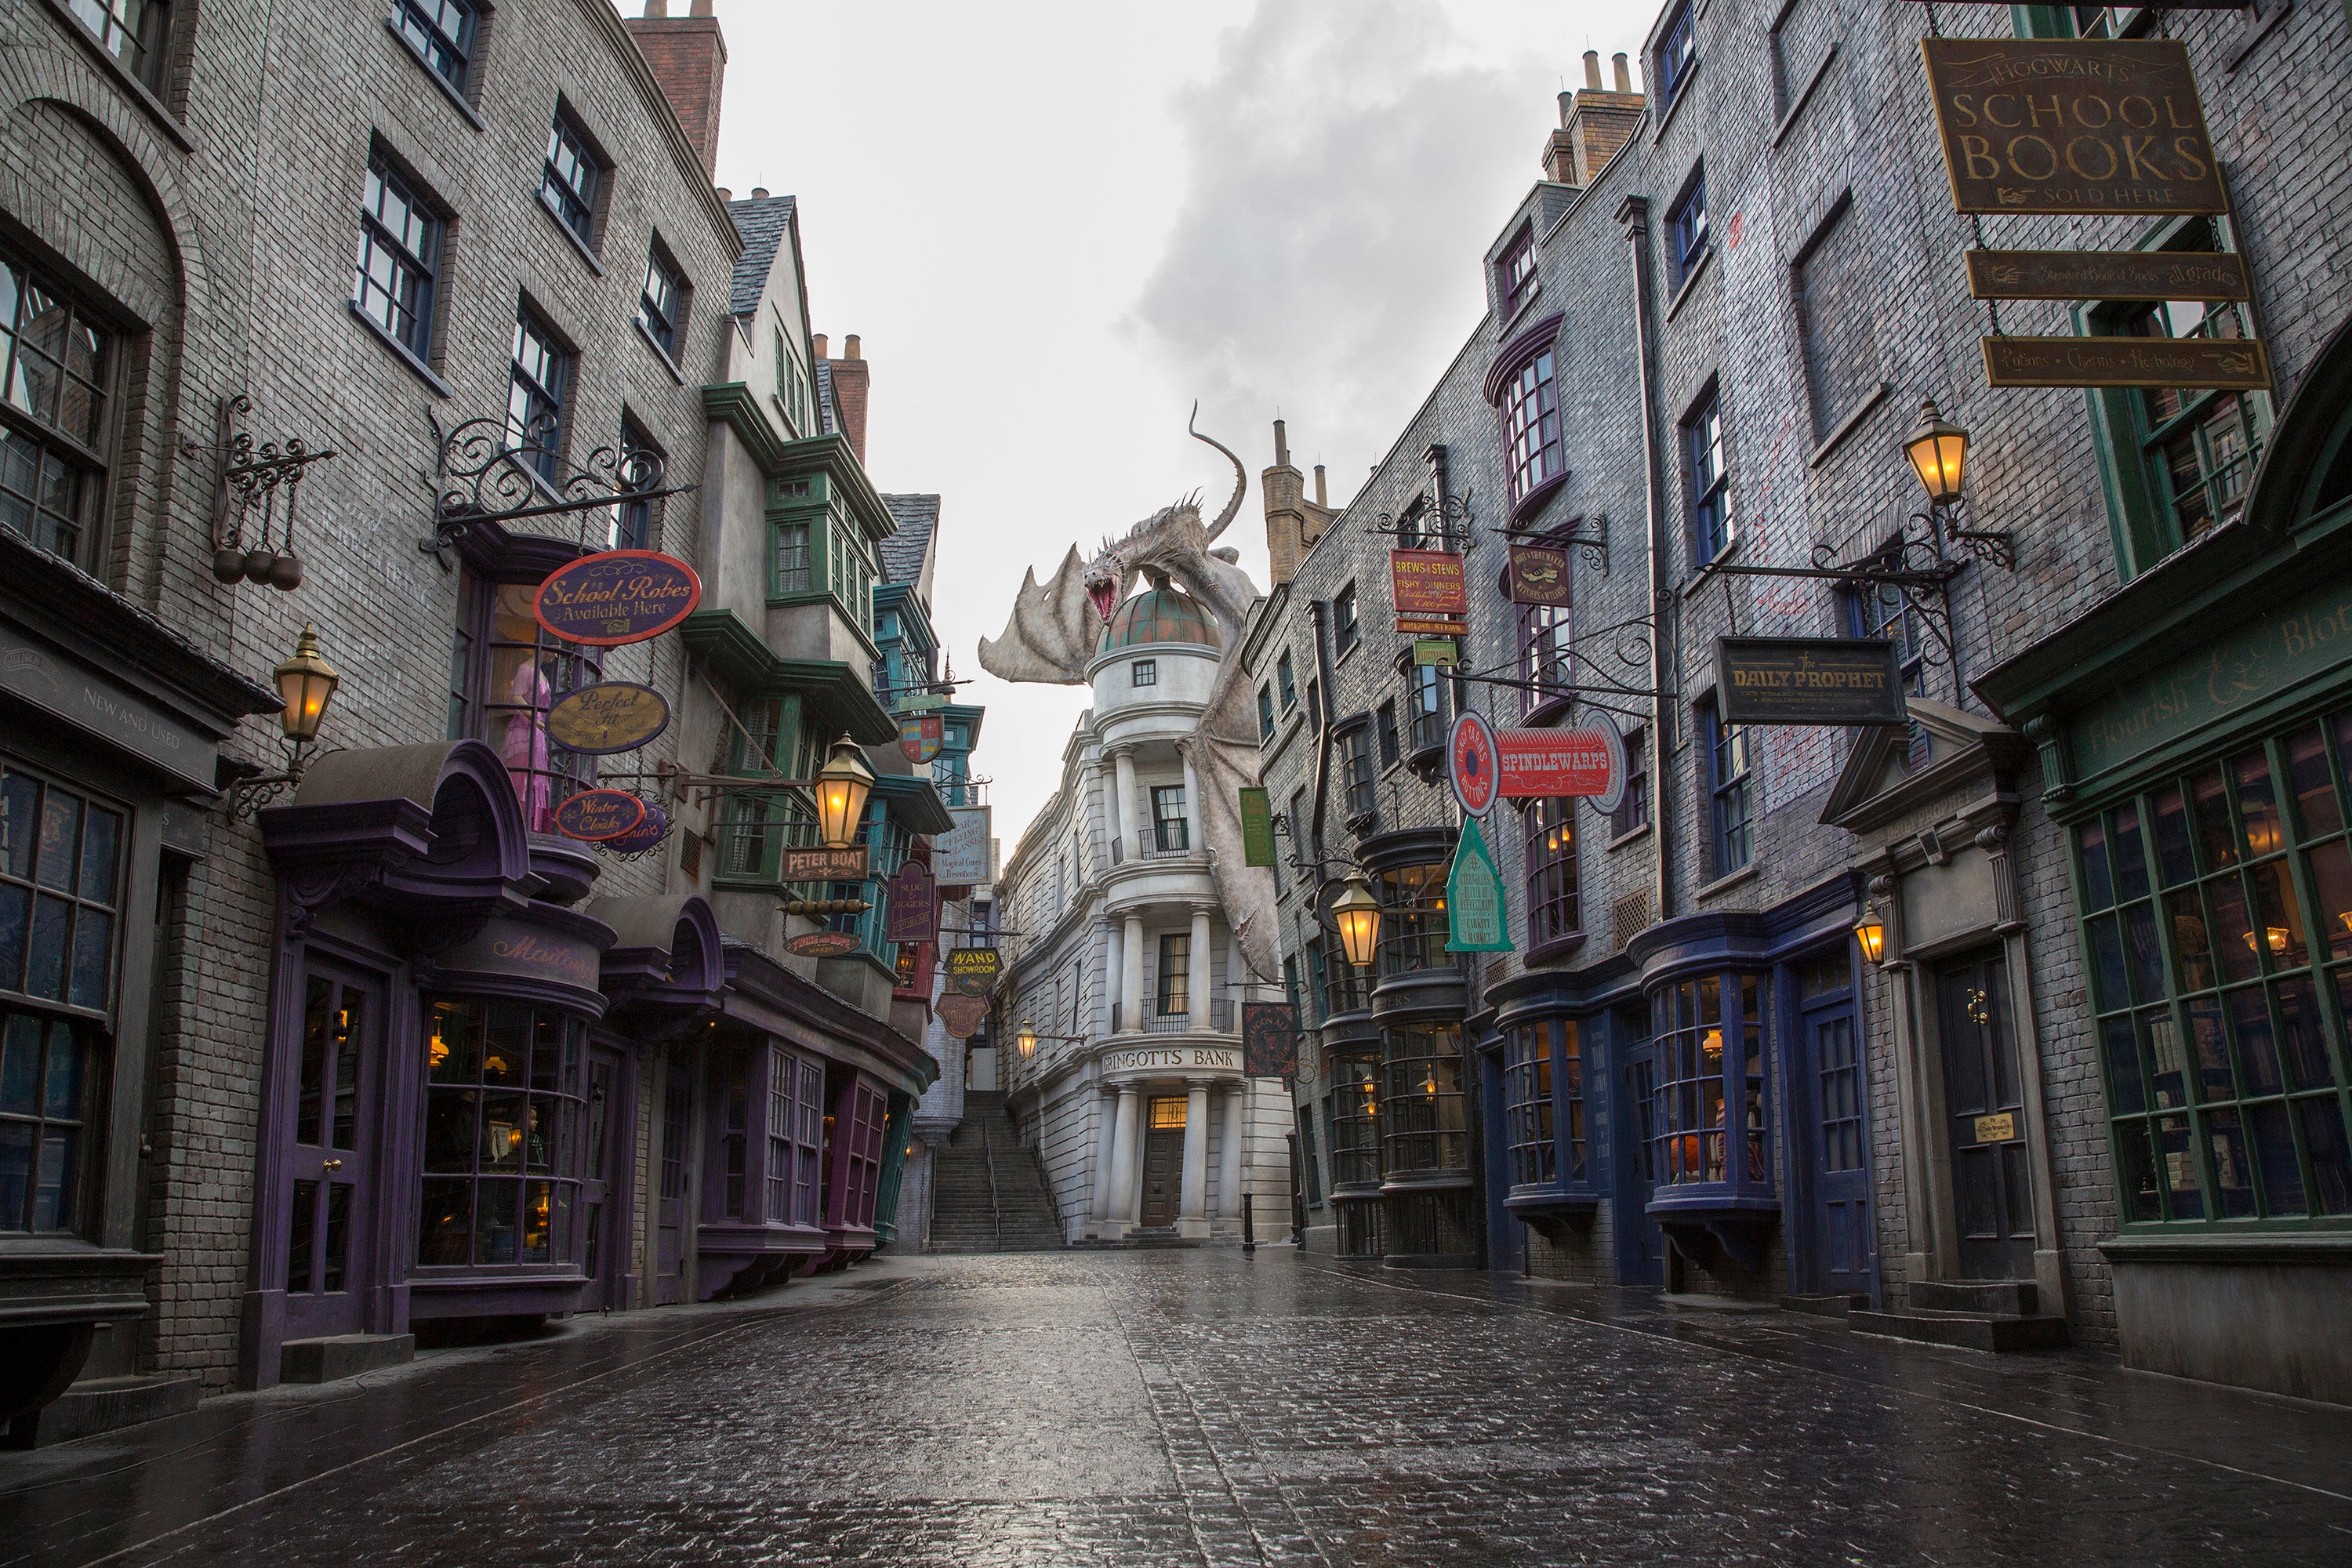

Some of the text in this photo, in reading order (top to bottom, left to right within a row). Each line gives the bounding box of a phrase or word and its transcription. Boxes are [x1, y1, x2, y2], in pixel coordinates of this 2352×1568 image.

[1994, 58, 2132, 83] HOGWARTS
[1953, 93, 2194, 129] SCHOOL
[1958, 134, 2209, 182] BOOKS
[2044, 188, 2178, 205] SOLD HERE
[2041, 264, 2237, 286] Standard Book of Spells all grades
[2002, 347, 2194, 372] Potions Charms Herbology
[1396, 561, 1425, 573] BREWS
[1432, 563, 1460, 575] STEWS
[1513, 552, 1527, 565] BOOT
[1530, 550, 1566, 568] SHOEMAKER
[543, 575, 691, 607] School Robes
[1425, 581, 1461, 590] DINNERS
[1516, 581, 1541, 600] WITCHES
[1544, 585, 1567, 601] WIZARDS
[562, 601, 666, 622] Available Here
[1403, 622, 1431, 630] BREWS
[1798, 652, 1816, 672] The
[1733, 670, 1886, 688] DAILY PROPHET
[580, 688, 641, 713] Perfect
[84, 687, 180, 750] NEW AND USED
[594, 710, 619, 726] Fit
[2088, 679, 2190, 755] Flourish
[1457, 724, 1488, 763] FANCY YARNS
[1502, 751, 1608, 772] SPINDLEWARPS
[1598, 724, 1618, 797] NEVER-TANGLE WOOL
[1461, 775, 1489, 804] BUTTONS
[580, 797, 619, 815] Winter
[579, 815, 622, 831] Cloaks
[949, 827, 978, 846] FLYING
[789, 851, 863, 874] PETER BOAT
[942, 858, 982, 868] Magical Cures
[946, 869, 978, 878] Preventions
[1464, 887, 1488, 898] ELIXIR OF
[893, 900, 930, 909] JIGGERS
[1460, 898, 1494, 911] REFRESHMENT
[892, 913, 930, 930] APOTHECARY
[1466, 918, 1490, 929] CARKITT
[793, 935, 818, 953] TWINE
[830, 935, 851, 950] ROPE
[1468, 932, 1491, 943] MARKET
[953, 952, 996, 964] WAND
[953, 965, 996, 975] SHOWROOM
[1247, 1018, 1273, 1039] DIAGON
[1103, 1049, 1182, 1073] GRINGOTTS
[1193, 1049, 1233, 1068] BANK
